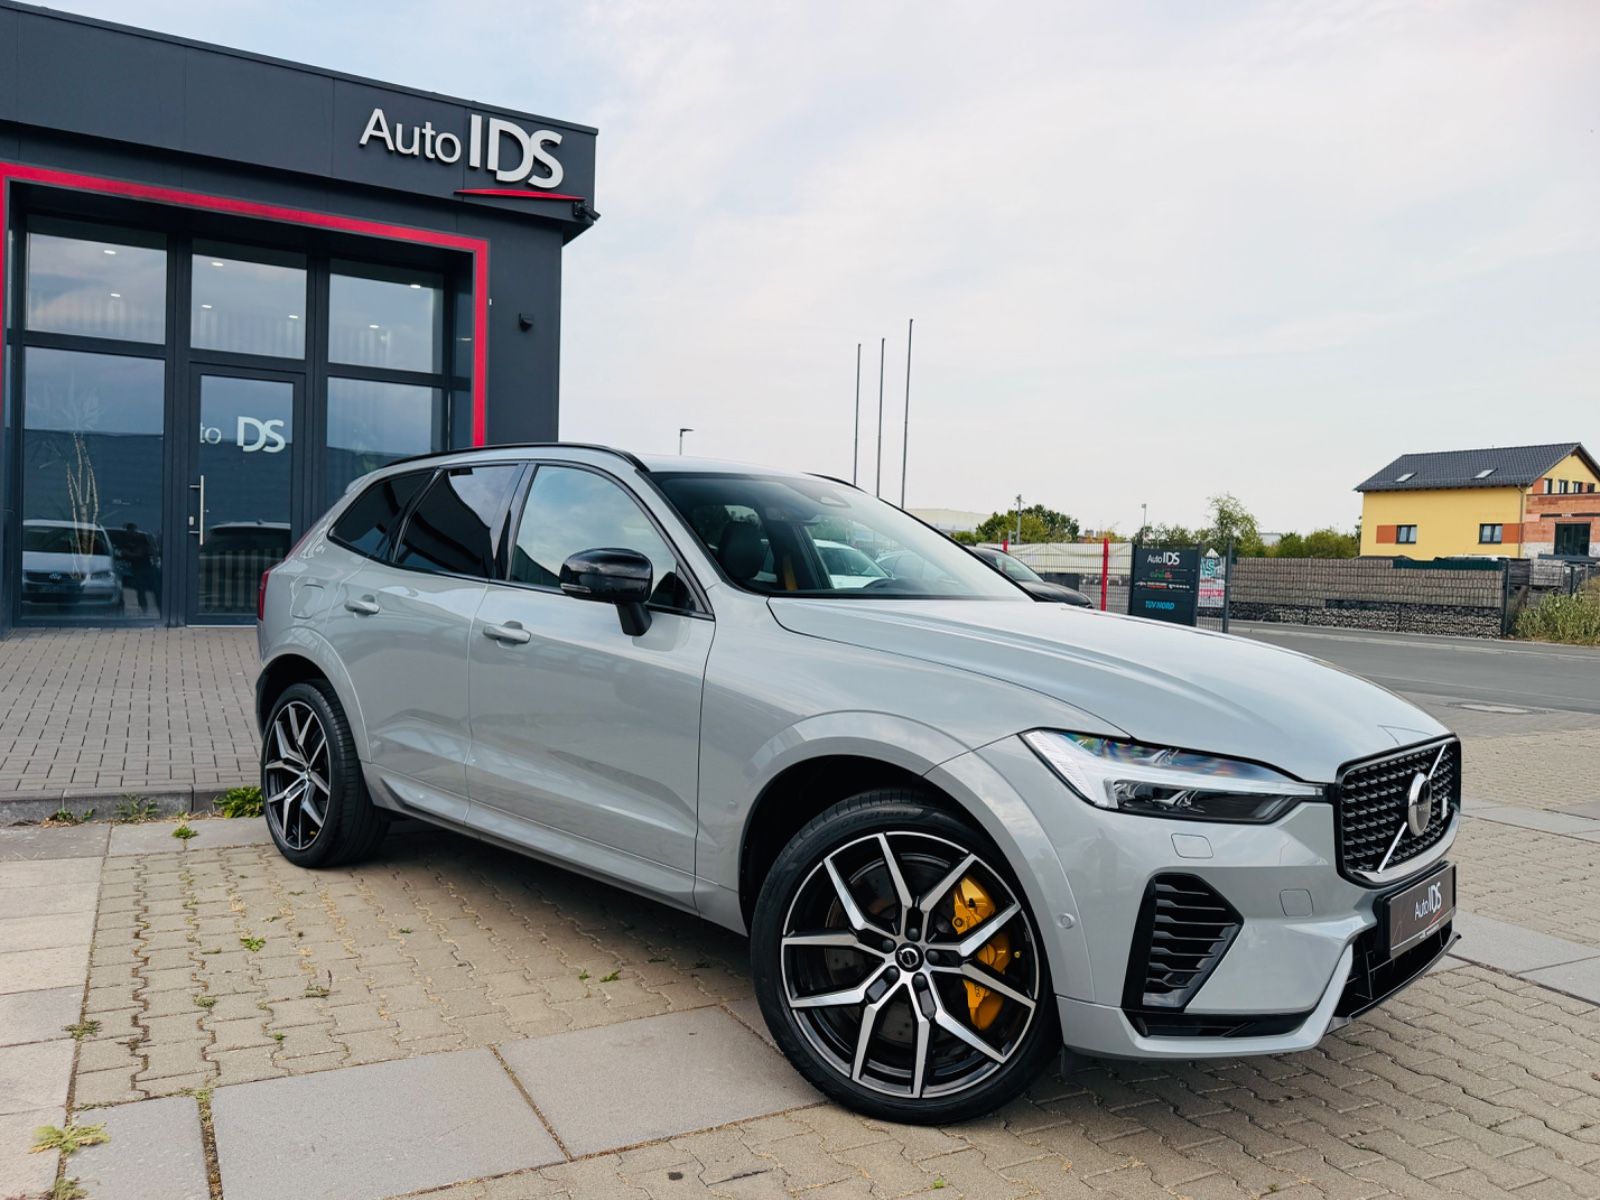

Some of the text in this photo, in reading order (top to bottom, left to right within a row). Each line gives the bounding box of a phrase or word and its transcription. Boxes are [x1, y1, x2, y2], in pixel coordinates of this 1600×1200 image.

[359, 108, 564, 189] Auto IDS
[1147, 551, 1180, 565] Auto IDS
[1414, 882, 1442, 920] Auto IDS
